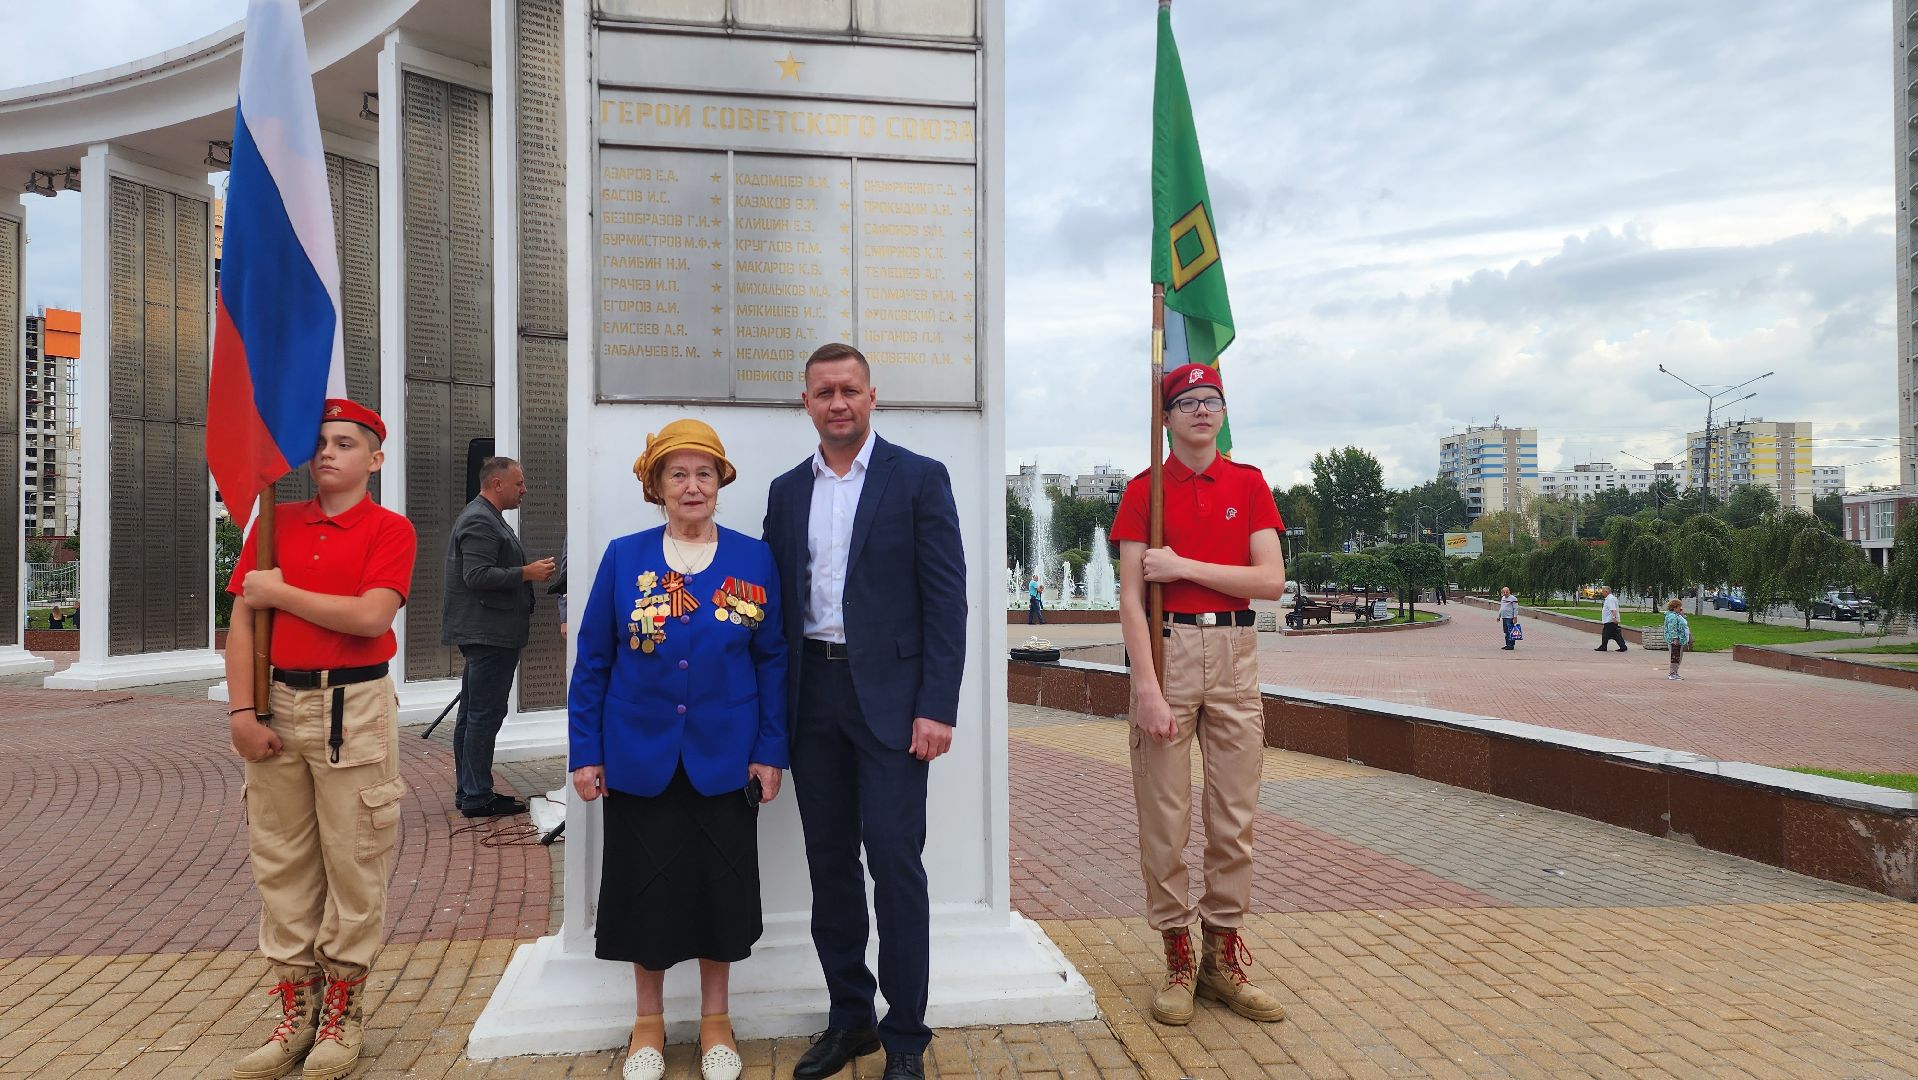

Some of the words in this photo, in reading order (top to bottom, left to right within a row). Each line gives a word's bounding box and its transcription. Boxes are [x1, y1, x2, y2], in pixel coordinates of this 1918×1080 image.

[600, 99, 691, 129] ГЕРОИ
[702, 105, 876, 138] СОВЕТСКОГО
[886, 115, 975, 144] СОЮЗА
[603, 166, 652, 181] АЗАРОВ
[656, 168, 679, 182] Е.А.
[735, 172, 803, 188] КАДОМЦЕВ
[602, 188, 643, 202] БАСОВ
[647, 190, 671, 204] И.С.
[735, 194, 791, 210] КАЗАКОВ
[602, 211, 683, 227] БЕЗОБРАЗОВ
[687, 214, 711, 228] Г.И.
[735, 217, 789, 232] КЛИШИН
[602, 233, 682, 248] БУРМИСТРОВ
[684, 236, 711, 249] М.Ф.
[735, 238, 793, 254] КРУГЛОВ
[864, 244, 921, 258] СМИРНОВ
[602, 255, 662, 270] ГАЛИБИН
[666, 257, 691, 271] Н.И.
[736, 260, 794, 275] МАКАРОВ
[602, 277, 652, 291] ГРАЧЕВ
[656, 279, 680, 292] И.П.
[603, 299, 652, 313] ЕГОРОВ
[656, 301, 680, 314] А.И.
[736, 304, 799, 318] МЯКИШЕВ
[603, 321, 660, 336] ЕЛИСЕЕВ
[664, 323, 688, 337] А.Я.
[736, 325, 791, 340] НАЗАРОВ
[603, 343, 669, 357] ЗАБАЛУЕВ
[736, 348, 794, 361] НЕЛИДОВ
[736, 369, 794, 382] НОВИКОВ
